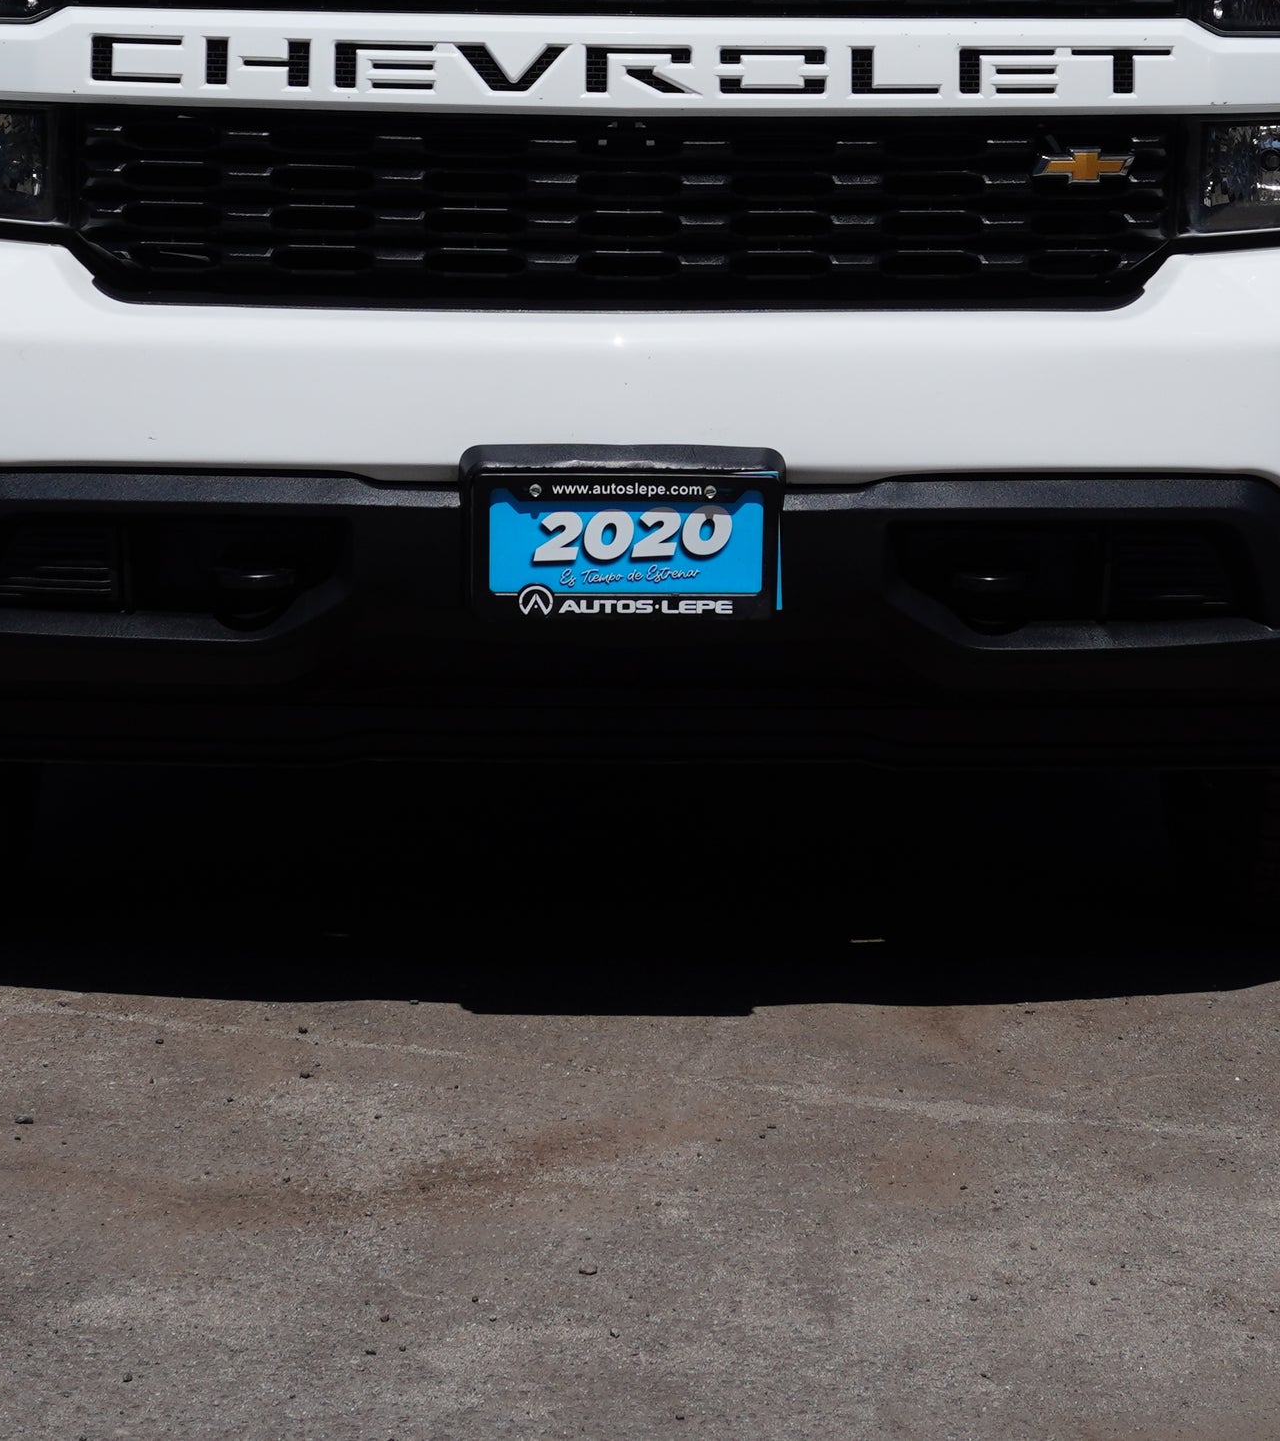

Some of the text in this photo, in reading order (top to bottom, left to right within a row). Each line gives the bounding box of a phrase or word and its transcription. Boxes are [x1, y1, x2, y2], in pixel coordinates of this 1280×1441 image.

[90, 33, 1175, 97] CHEVROLET
[552, 482, 703, 498] www.autoslepe.com
[532, 505, 734, 562] 2020
[559, 564, 701, 587] Es Tiempo de Estrenar
